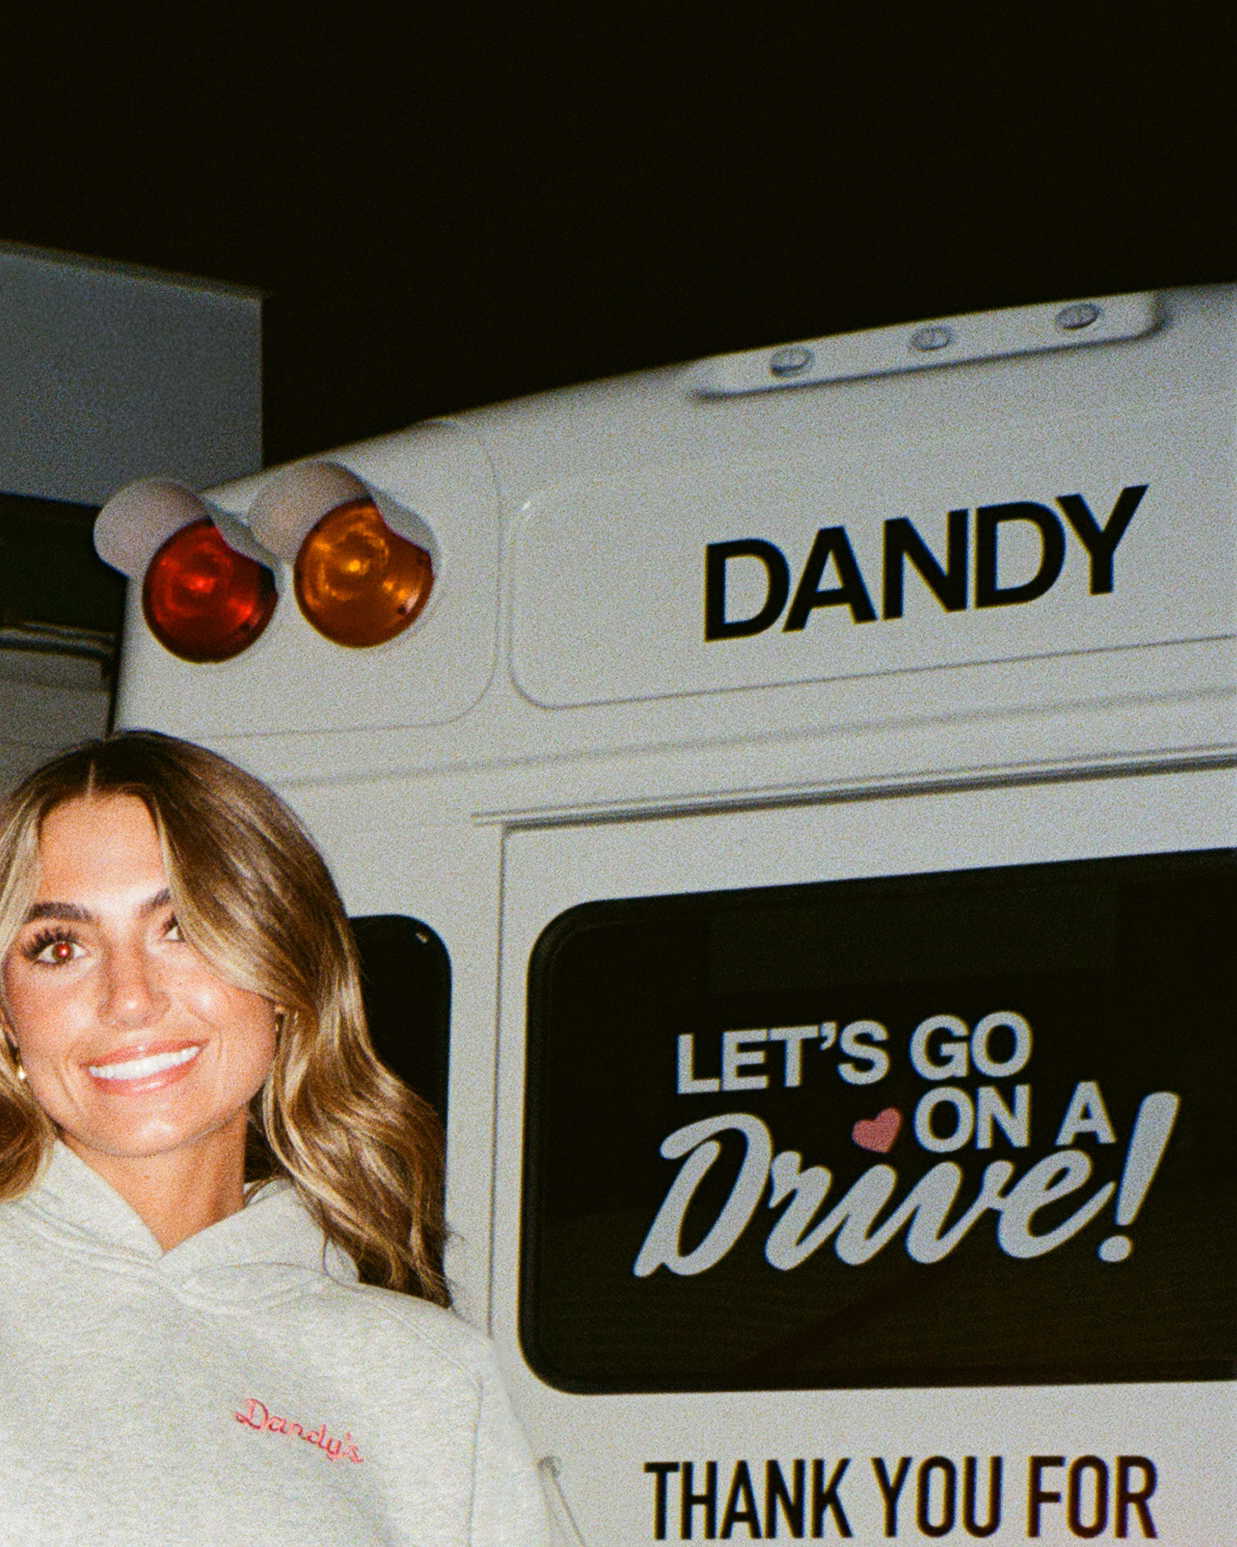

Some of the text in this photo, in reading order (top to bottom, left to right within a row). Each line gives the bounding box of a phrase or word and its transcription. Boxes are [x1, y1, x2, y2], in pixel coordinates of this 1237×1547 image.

[704, 484, 1148, 642] DANDY
[676, 1011, 1033, 1094] LET'S GO
[913, 1081, 1116, 1153] ON A
[633, 1091, 1180, 1277] Drive!
[235, 1397, 365, 1464] Dandy's
[644, 1454, 1158, 1540] THANK YOU FOR
